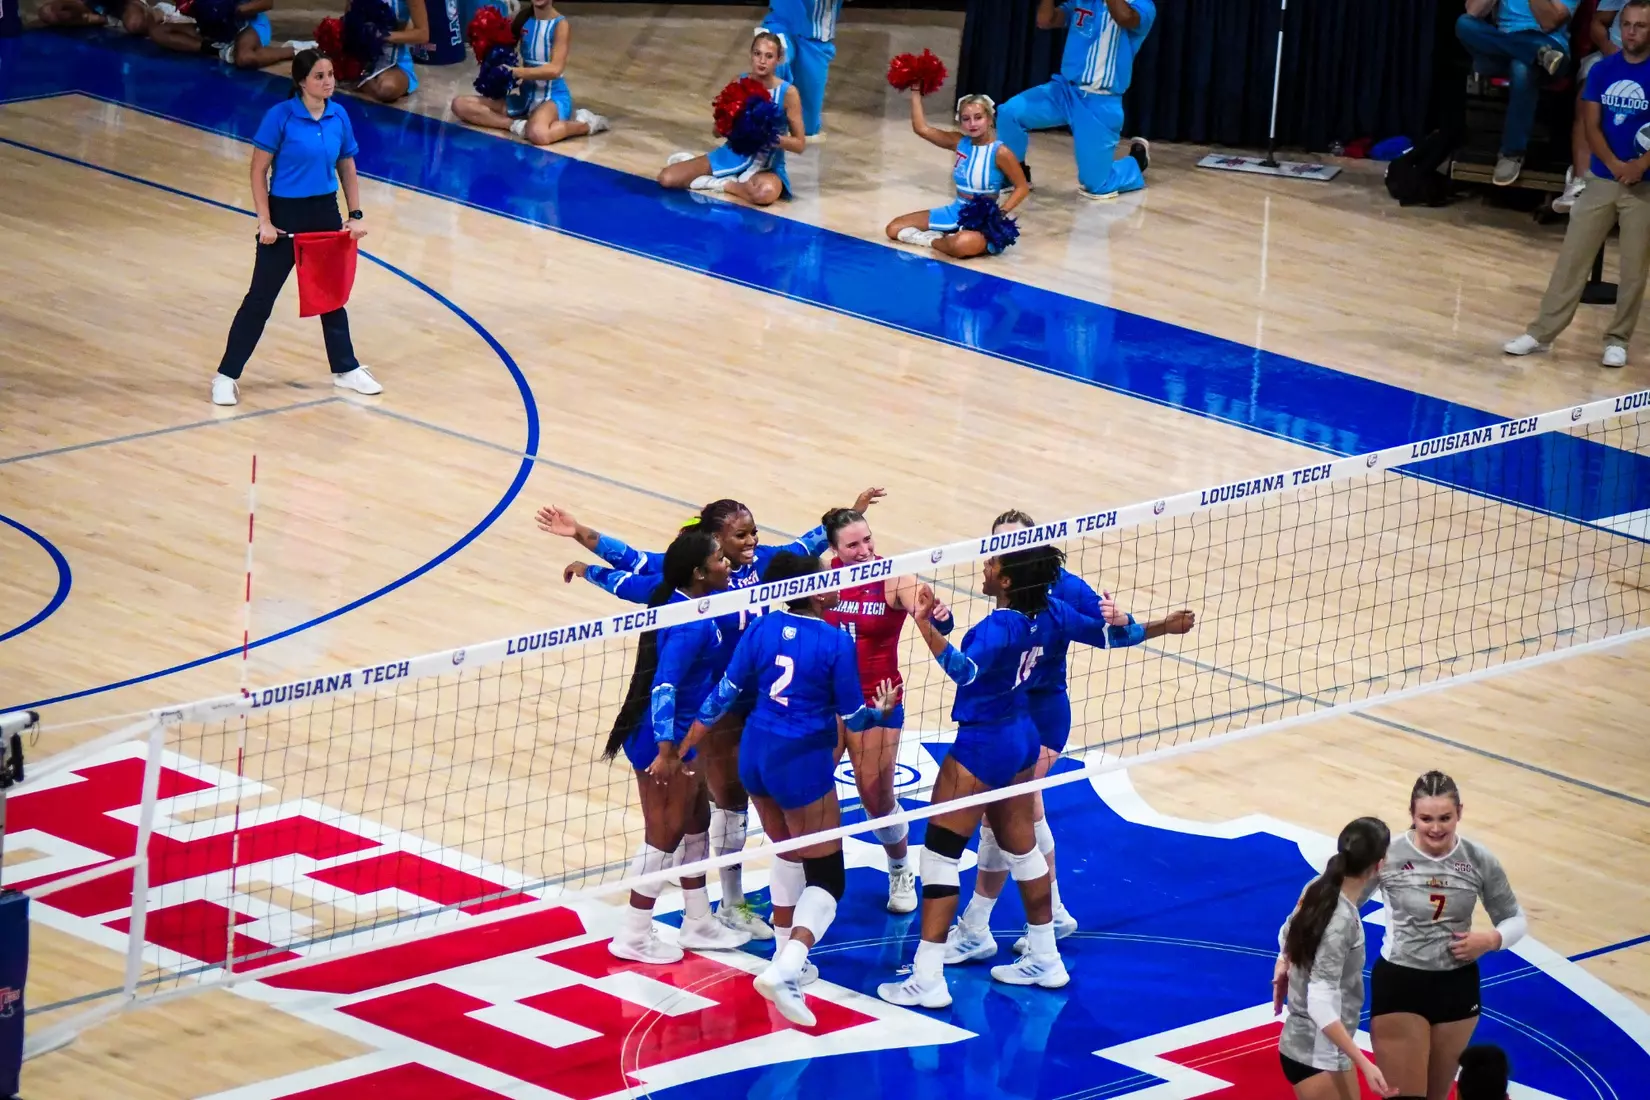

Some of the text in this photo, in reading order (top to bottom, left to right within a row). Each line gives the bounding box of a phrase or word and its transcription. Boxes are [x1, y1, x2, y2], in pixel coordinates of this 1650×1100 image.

[1074, 7, 1094, 27] T
[1600, 94, 1649, 110] BULLDOG
[1614, 392, 1650, 413] LOUI
[1411, 417, 1538, 458] LOUISIANA TECH
[1200, 464, 1332, 506] LOUISIANA TECH
[980, 511, 1117, 554] LOUISIANA TECH
[750, 571, 841, 604] LOUISIANA
[850, 560, 893, 582] TECH
[862, 601, 886, 616] TECH
[506, 609, 658, 655] LOUISIANA TECH
[251, 661, 410, 708] LOUISIANA TECH
[769, 654, 795, 706] 2
[1430, 894, 1446, 921] 7
